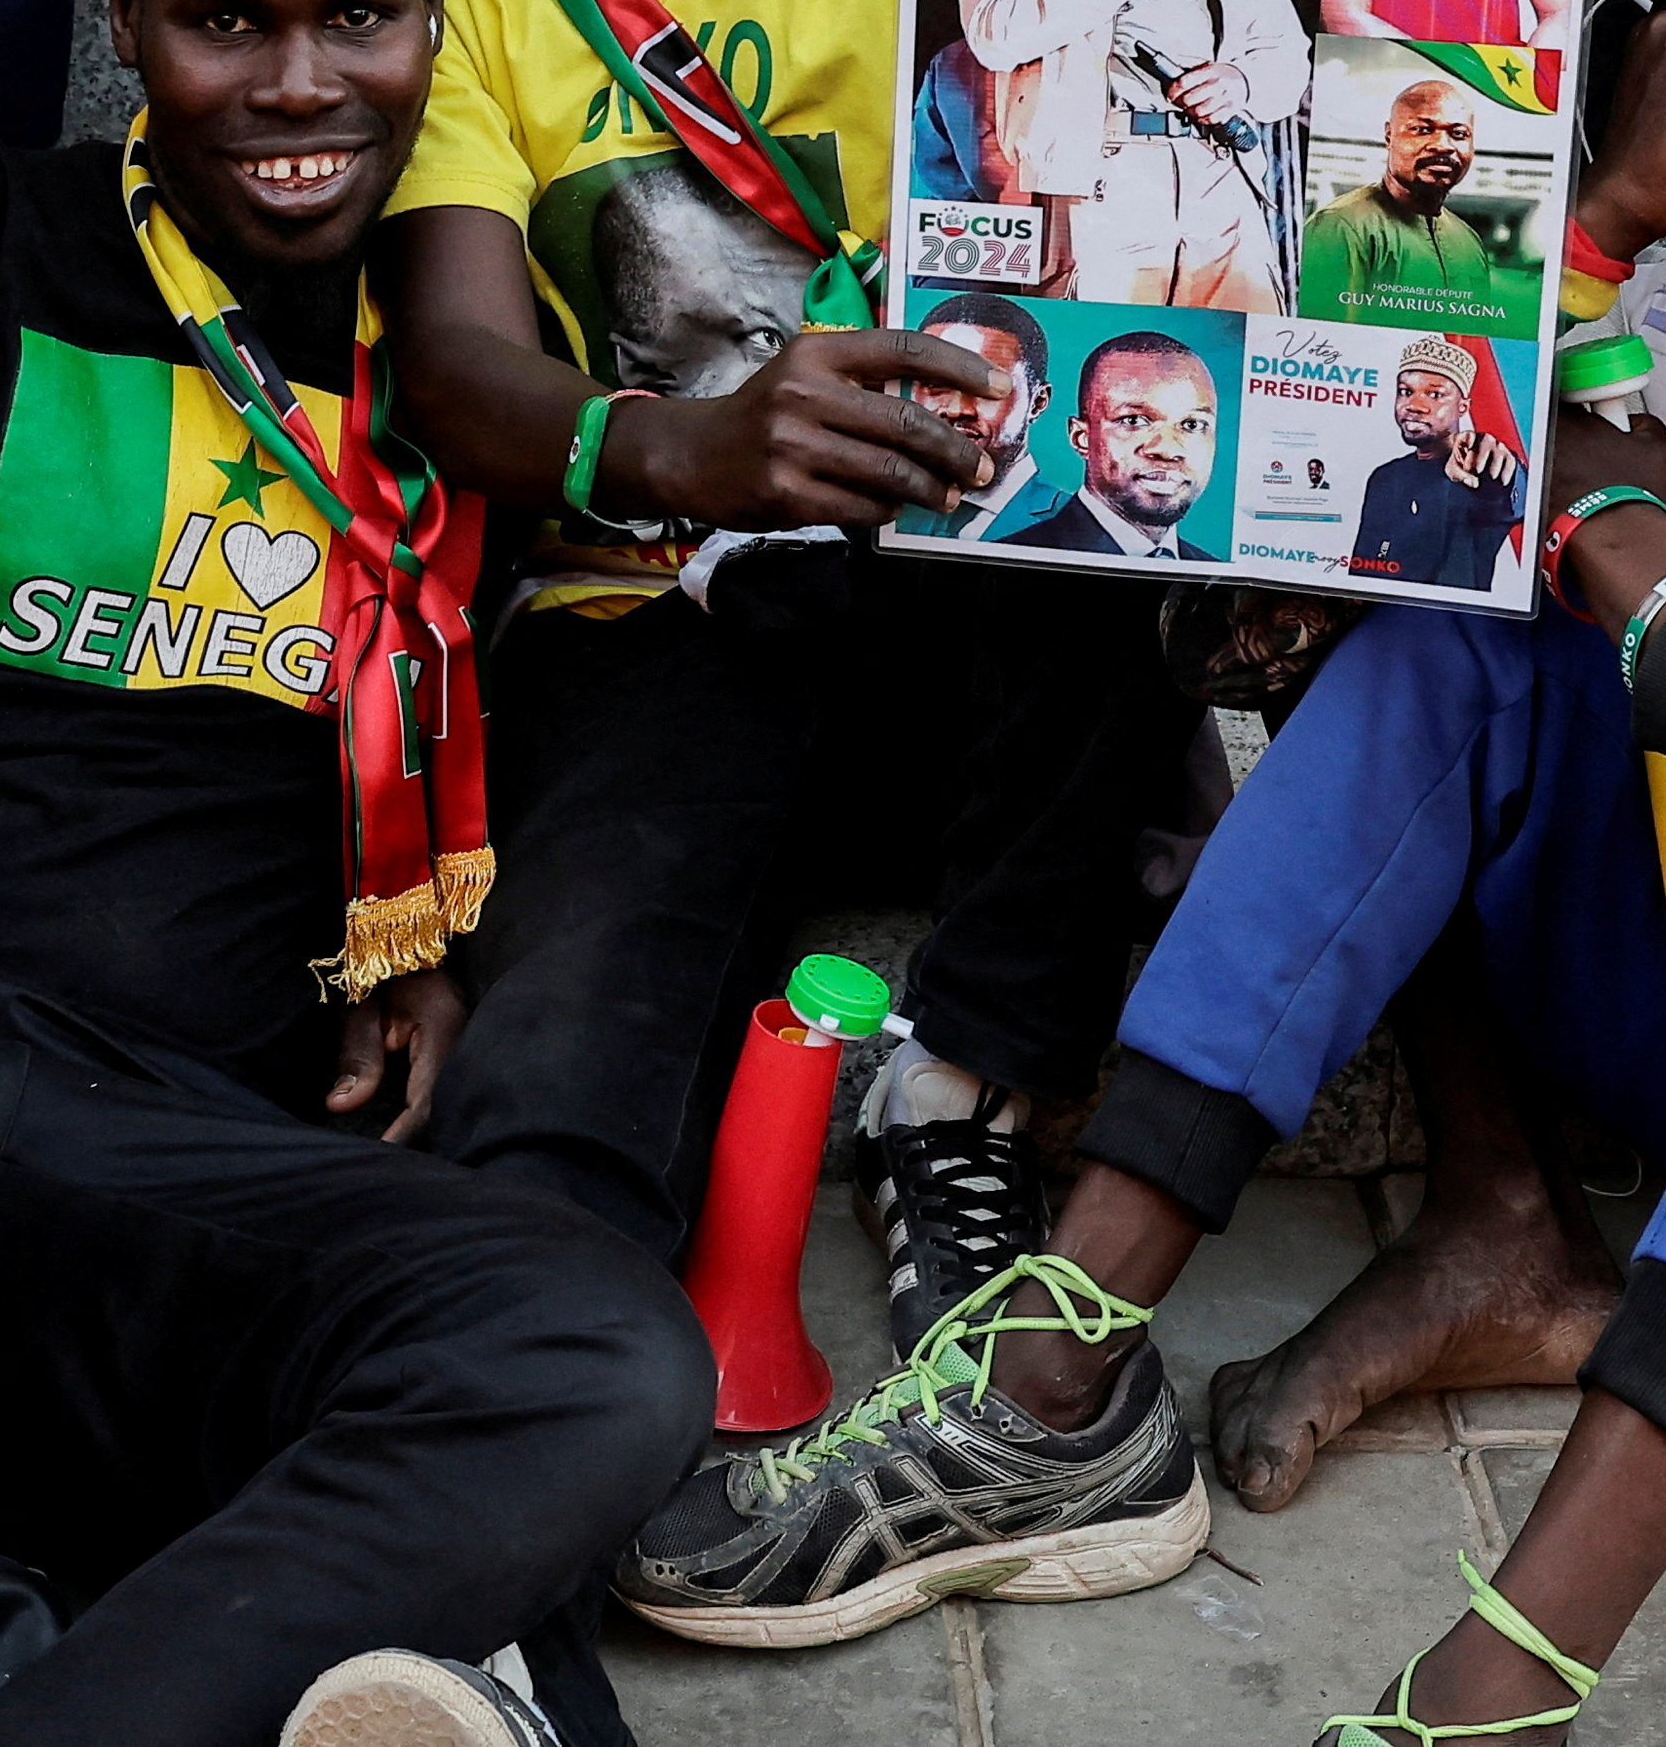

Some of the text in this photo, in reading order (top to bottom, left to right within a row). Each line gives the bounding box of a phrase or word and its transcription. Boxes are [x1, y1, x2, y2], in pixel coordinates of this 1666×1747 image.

[917, 235, 1032, 278] 2024
[1338, 291, 1506, 319] GUY MARIUS SAGNA
[1372, 282, 1433, 297] HONORABLE
[1276, 329, 1343, 365] Votez
[1250, 355, 1379, 387] DIOMAYE
[1249, 377, 1378, 408] PRÉSIDENT
[158, 511, 217, 592] I
[1238, 542, 1315, 564] DIOMAYE
[1339, 556, 1402, 574] SONKO
